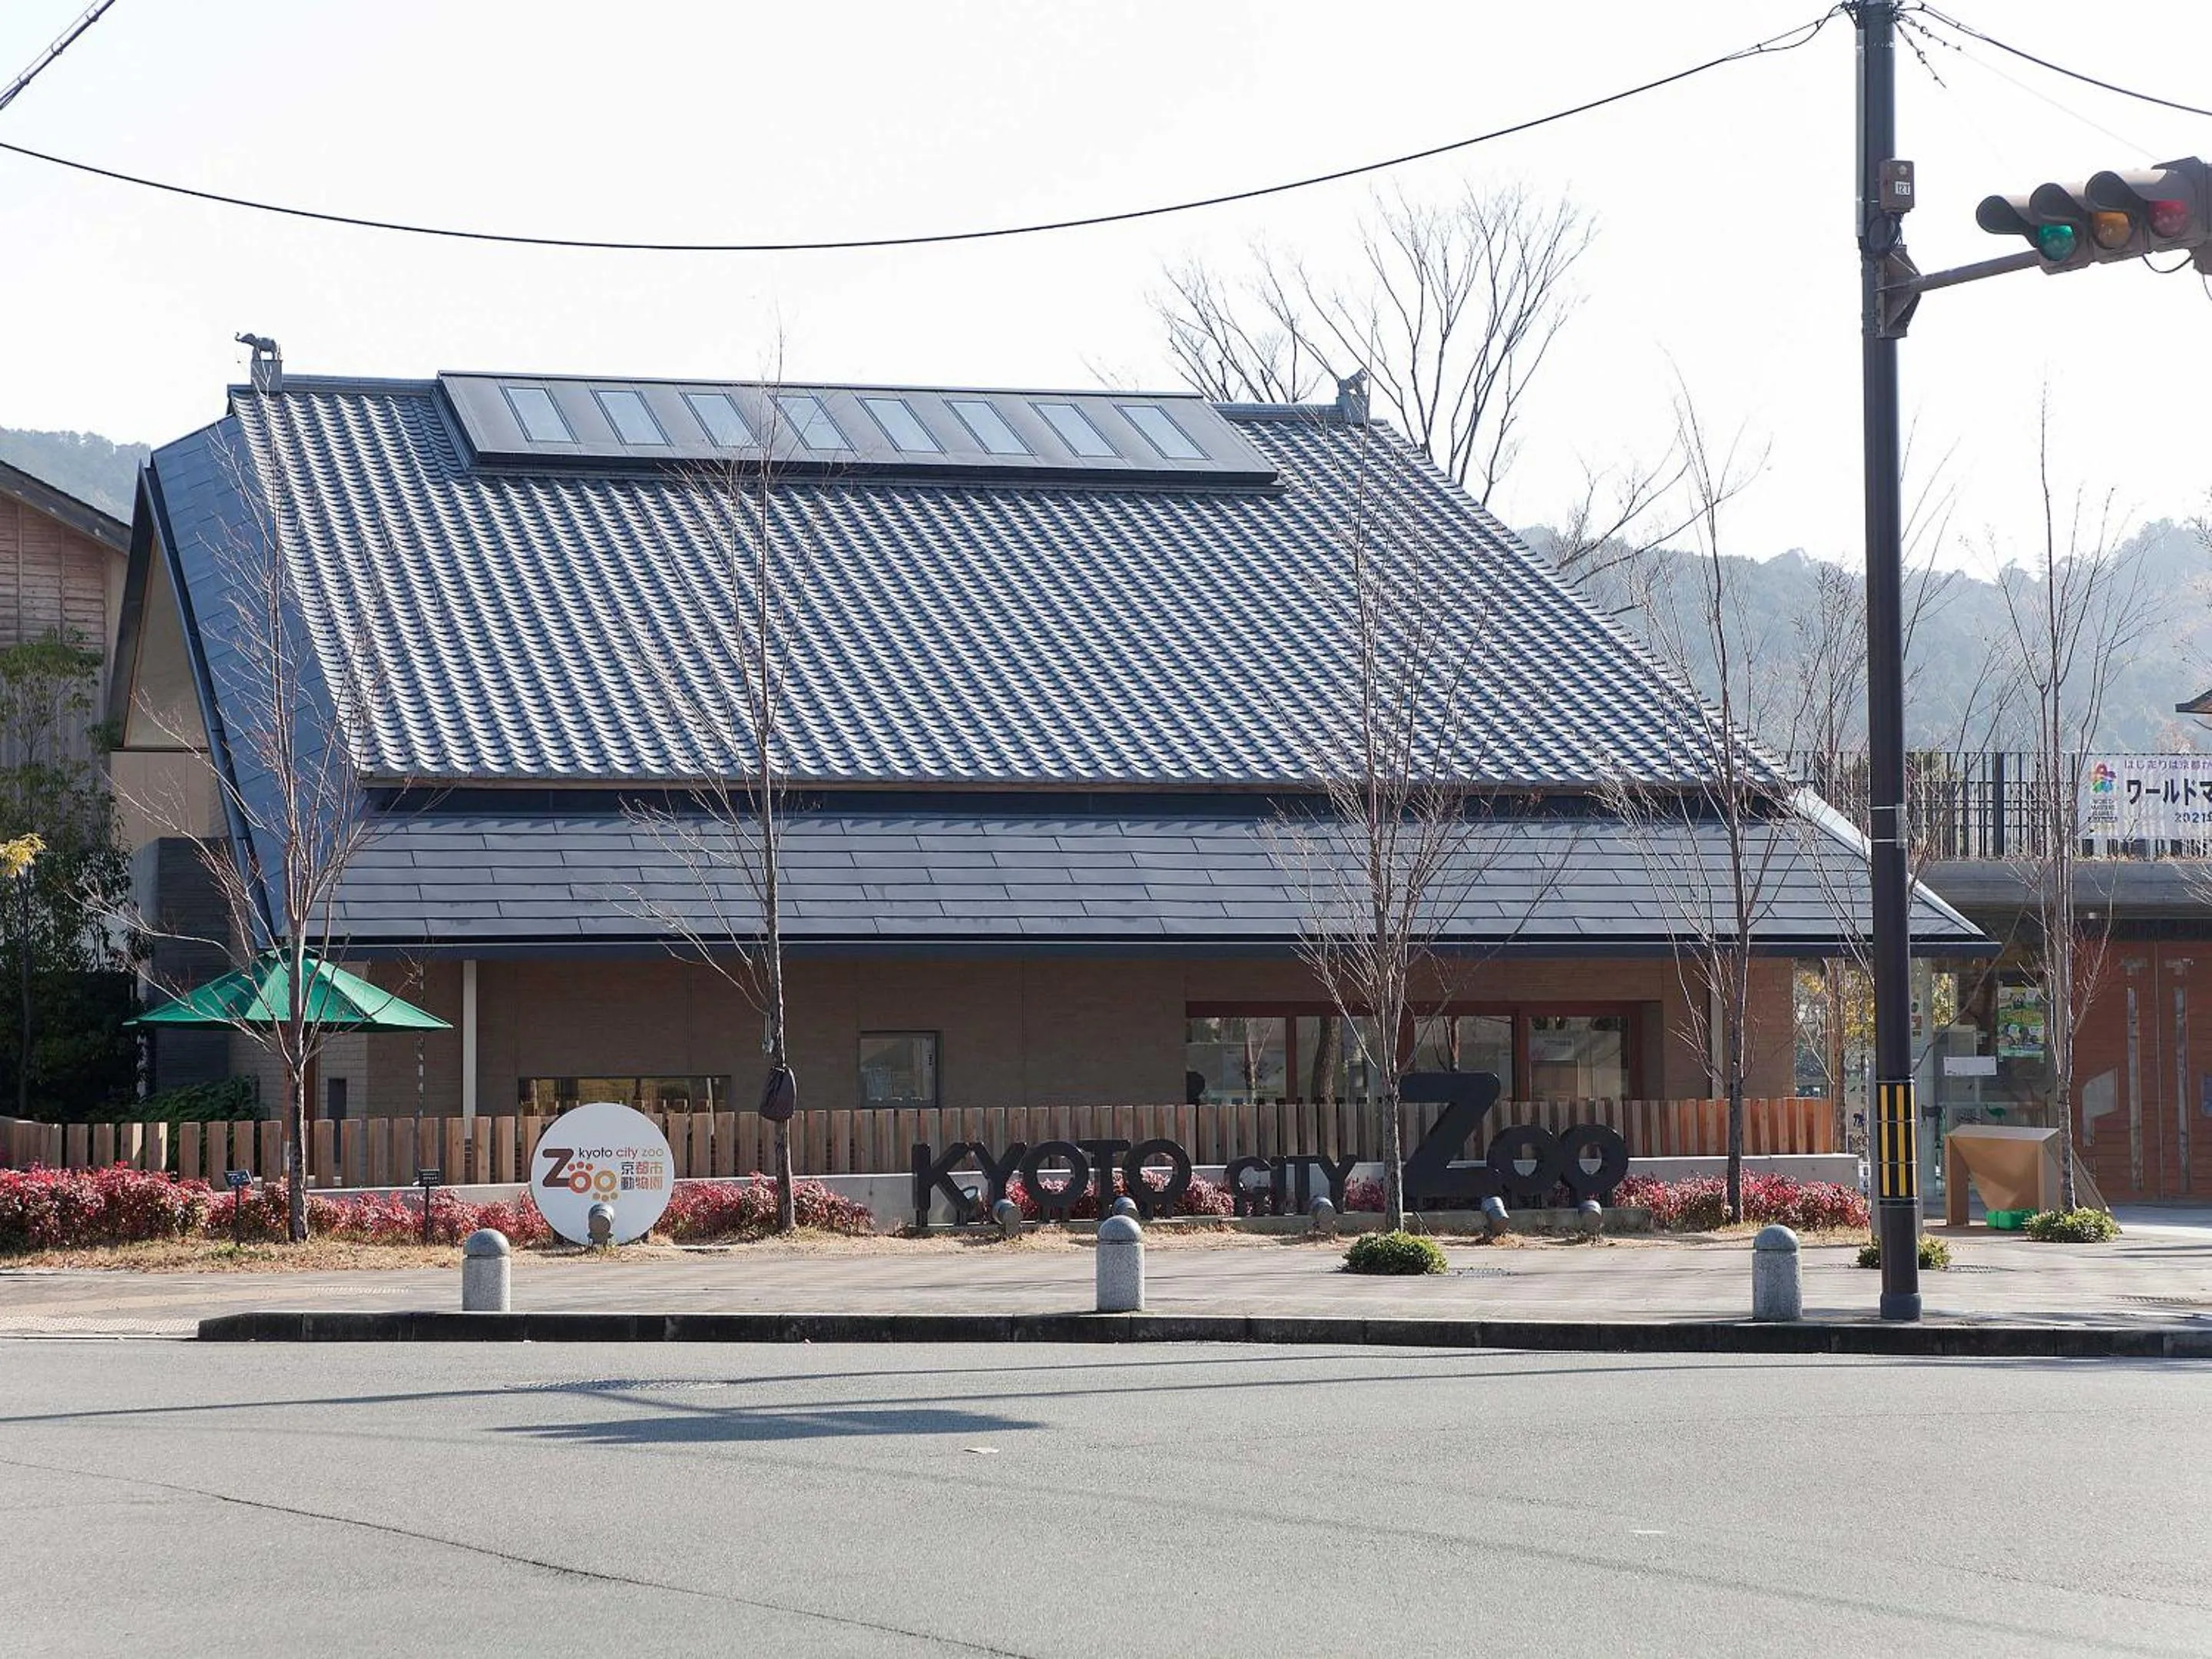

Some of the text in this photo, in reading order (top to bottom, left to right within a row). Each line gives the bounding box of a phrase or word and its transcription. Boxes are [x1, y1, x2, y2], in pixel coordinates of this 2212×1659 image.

[912, 1071, 1628, 1214] KYOTO CITY Zoo
[578, 1147, 664, 1159] kyoto city zoo
[621, 1161, 663, 1175] 京都市
[621, 1177, 663, 1190] 動物園
